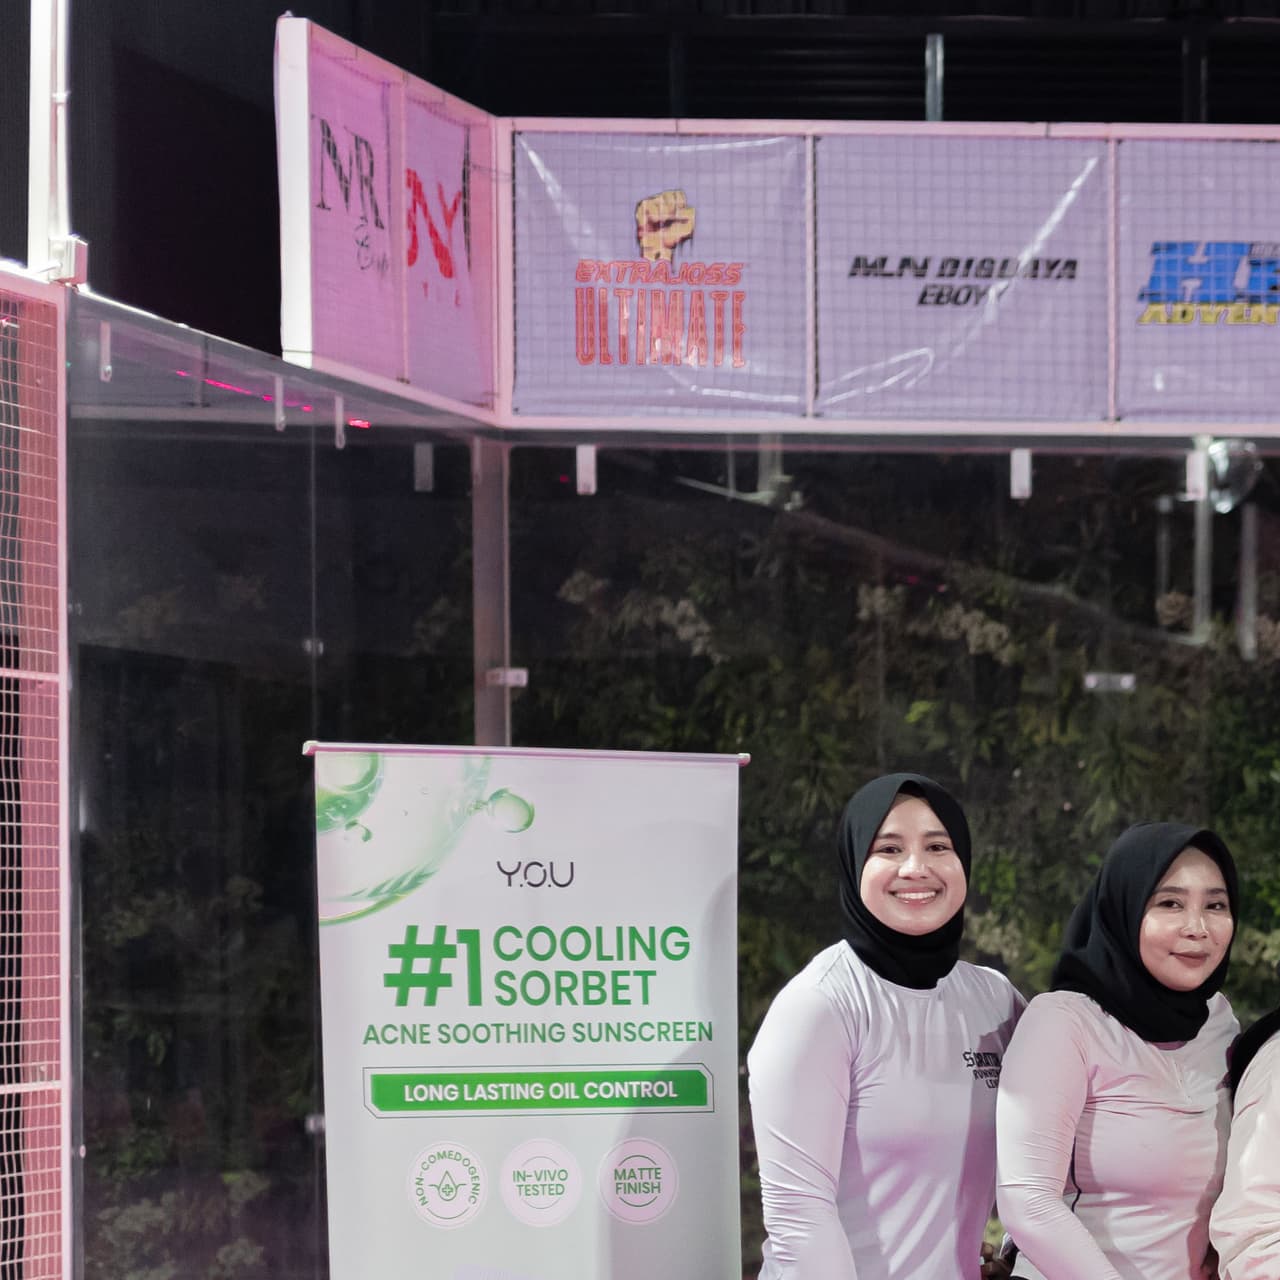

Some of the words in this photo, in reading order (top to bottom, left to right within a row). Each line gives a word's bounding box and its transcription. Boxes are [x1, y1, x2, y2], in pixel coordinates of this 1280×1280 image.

[405, 167, 463, 279] NY
[576, 287, 746, 369] ULTIMATE
[492, 925, 692, 962] COOLING
[383, 924, 484, 1008] #1
[493, 969, 658, 1007] SORBET
[362, 1023, 432, 1046] ACNE
[438, 1022, 566, 1045] SOOTHING
[572, 1020, 714, 1043] SUNSCREEN
[403, 1083, 460, 1103] LONG
[463, 1082, 544, 1102] LASTING
[548, 1082, 580, 1101] OIL
[583, 1080, 679, 1100] CONTROL
[415, 1150, 481, 1207] NON-COMEDOGENIC
[512, 1168, 569, 1183] IN-VIVO
[613, 1167, 663, 1181] MATTE
[614, 1181, 662, 1195] FINISH
[516, 1183, 566, 1197] TESTED
